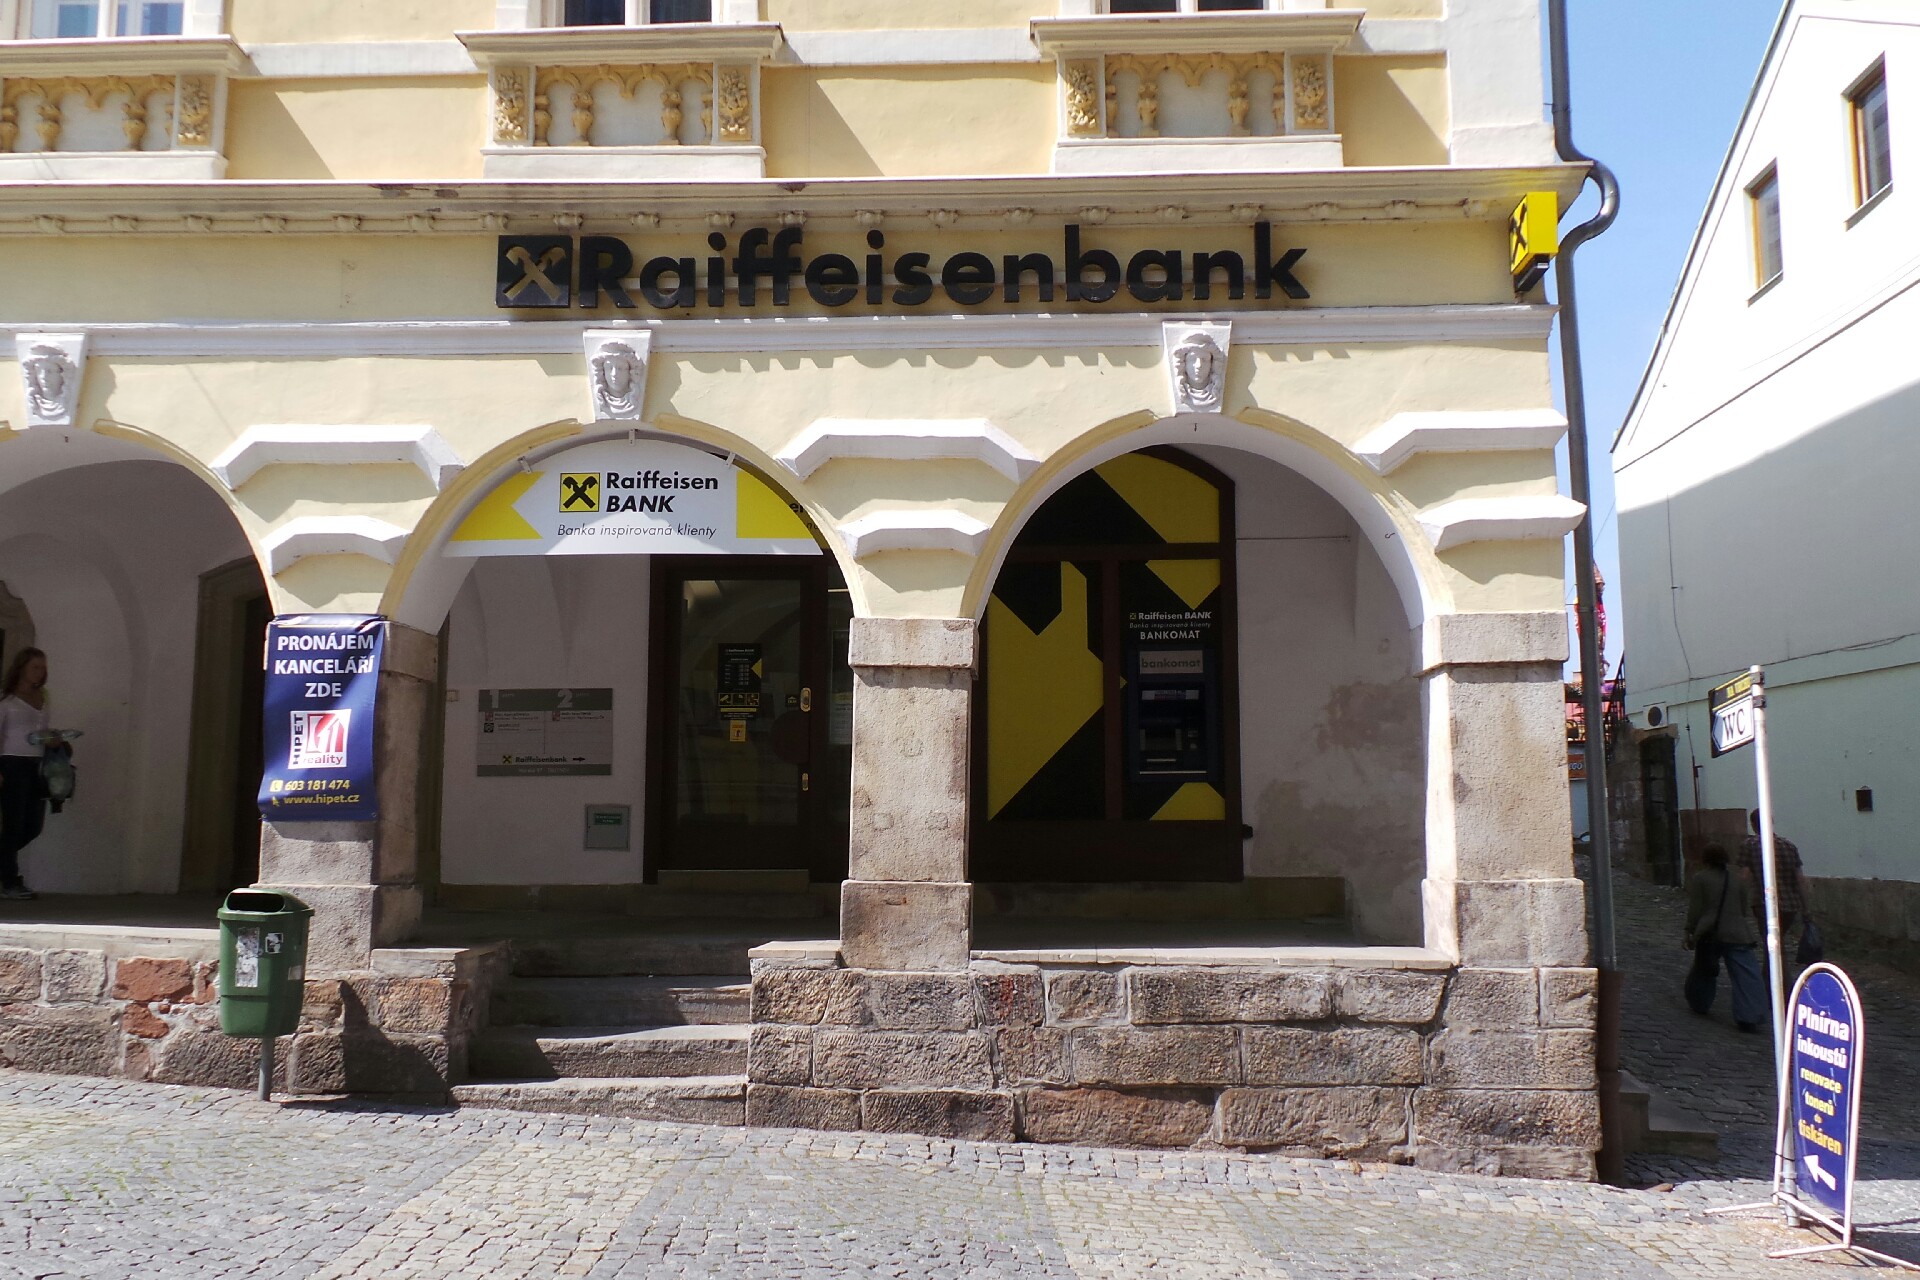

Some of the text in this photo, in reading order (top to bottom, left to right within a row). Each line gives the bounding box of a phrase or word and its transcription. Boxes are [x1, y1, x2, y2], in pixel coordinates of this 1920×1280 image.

[578, 222, 1310, 309] Raiffeisenbank
[605, 471, 719, 491] Raiffeisen
[605, 496, 675, 513] BANK
[557, 523, 717, 539] Banka inspirovaná klienty
[1138, 611, 1212, 620] Raiffeisen BANK
[277, 633, 374, 651] PRONÁJEM
[1139, 630, 1201, 640] BANKOMAT
[274, 655, 376, 675] KANCELÁŘÍ
[1141, 658, 1201, 669] bankomat
[305, 682, 342, 698] ZDE
[557, 689, 573, 709] 2
[1722, 708, 1746, 742] WC
[293, 713, 305, 765] HIPET
[284, 779, 350, 791] 603 181 474
[283, 793, 360, 805] www.hipet.cz
[1797, 1003, 1850, 1041] Plnírna
[1797, 1035, 1847, 1069] inkoustů
[1800, 1067, 1842, 1094] renovace
[1804, 1091, 1836, 1116] tonerů
[1797, 1119, 1843, 1156] tiskáren
